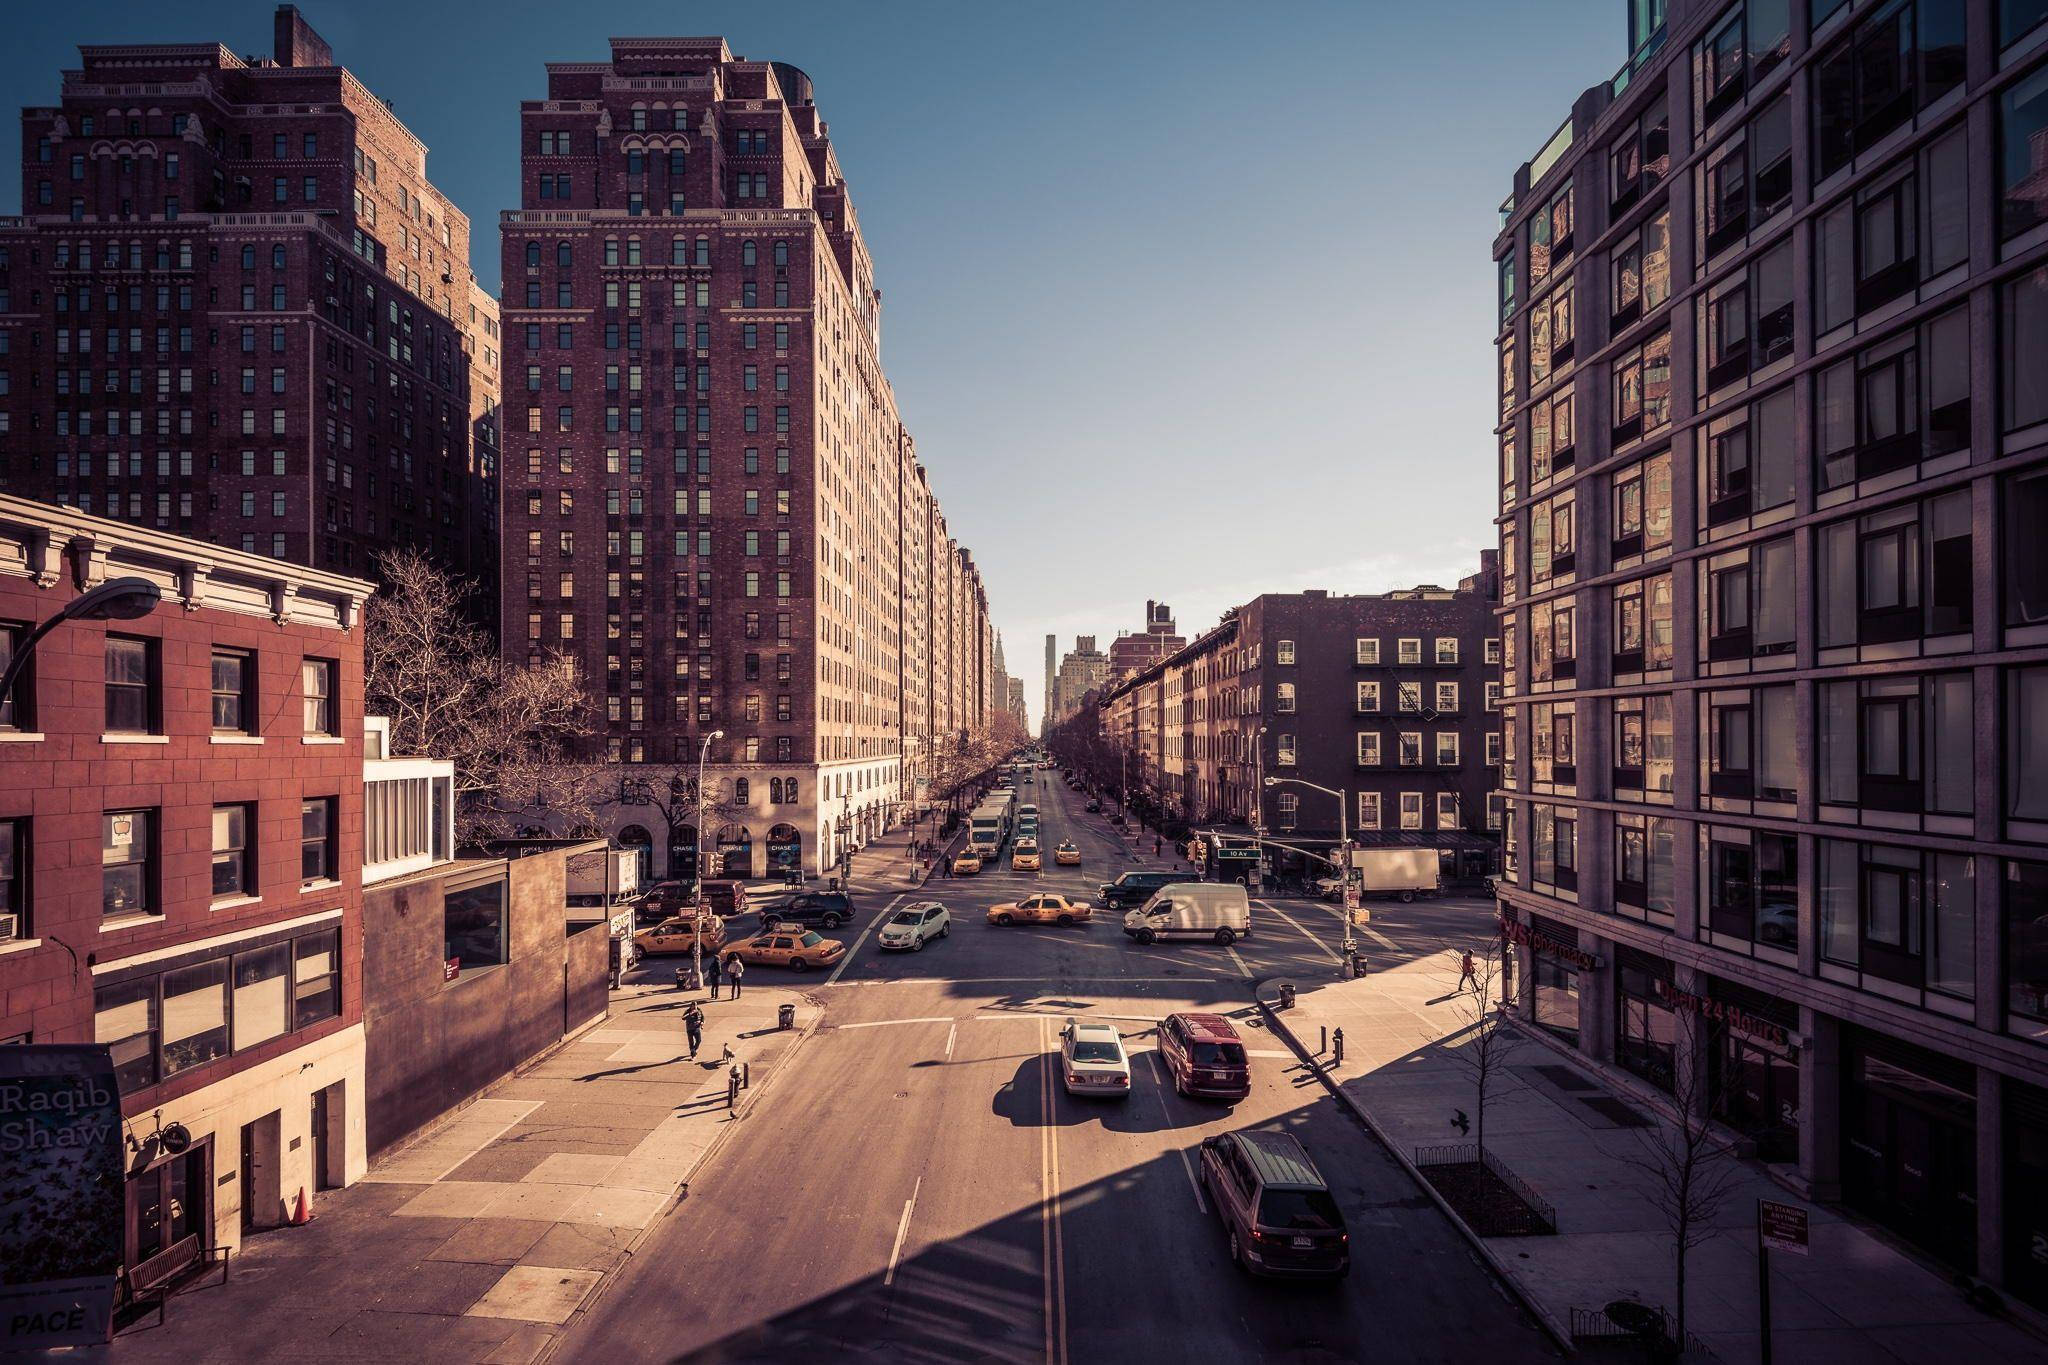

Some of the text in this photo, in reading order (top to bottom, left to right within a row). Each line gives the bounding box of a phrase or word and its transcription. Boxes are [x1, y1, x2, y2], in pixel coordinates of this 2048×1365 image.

[1660, 979, 1788, 1046] Open 24 Hours
[0, 1078, 112, 1115] Raqib
[0, 1117, 112, 1152] Shaw
[11, 1309, 86, 1336] PACE
